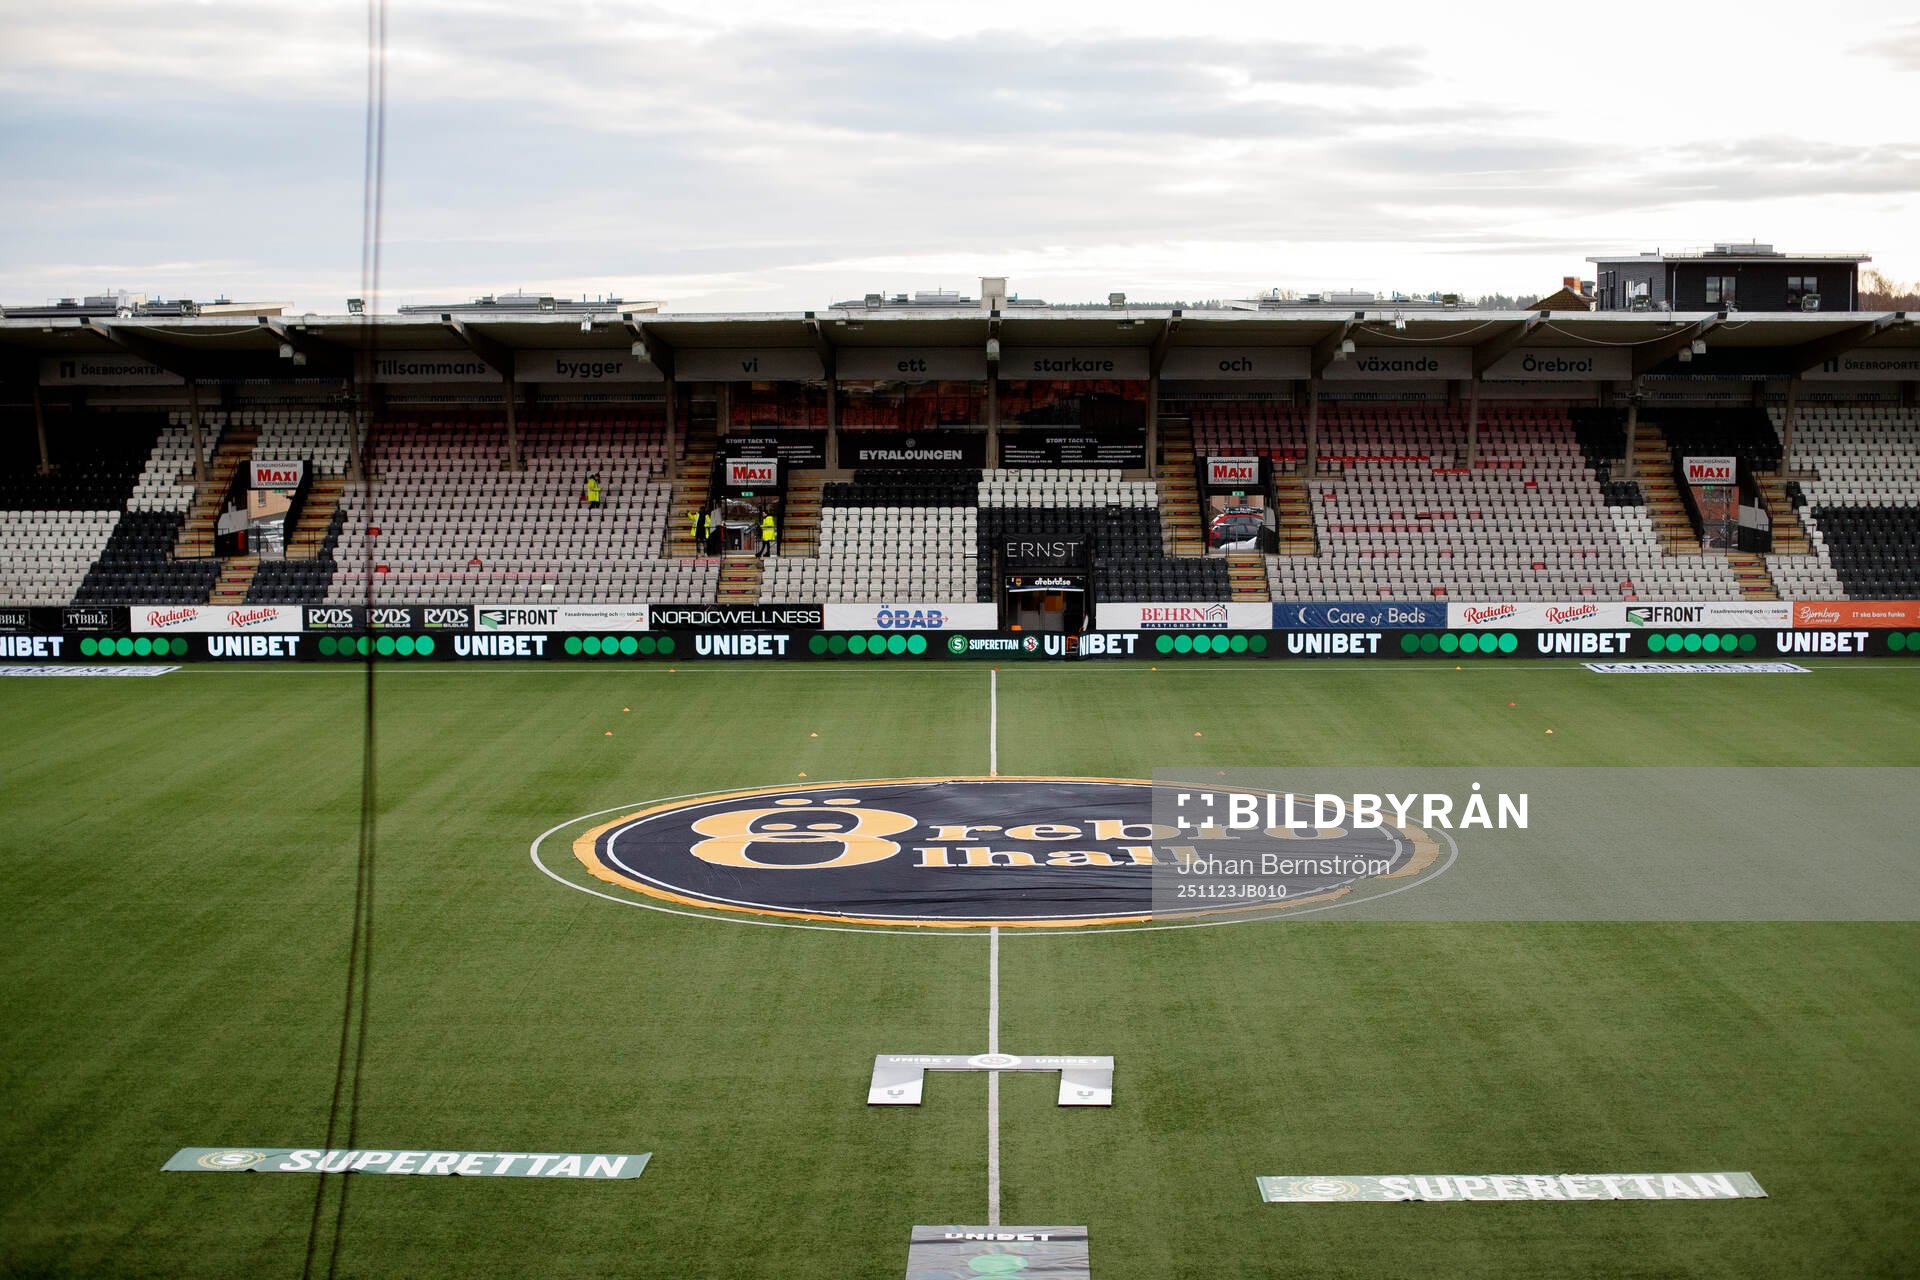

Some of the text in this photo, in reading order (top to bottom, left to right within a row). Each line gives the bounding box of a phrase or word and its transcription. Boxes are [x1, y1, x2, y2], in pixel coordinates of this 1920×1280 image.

[556, 360, 623, 378] bygger
[742, 358, 758, 373] vi
[897, 358, 927, 372] ett
[1033, 357, 1114, 372] starkare
[1219, 357, 1252, 372] och
[1357, 357, 1438, 372] växande
[1522, 354, 1593, 372] Örebro!
[859, 449, 963, 461] EYRALOUNGEN
[1007, 542, 1079, 558] ERNST
[66, 613, 108, 625] TYBBLE
[146, 607, 199, 627] Radiator
[226, 607, 279, 626] Radiator
[308, 608, 353, 624] RYDS
[366, 608, 411, 624] RYDS
[424, 608, 469, 624] RYDS
[508, 609, 557, 625] FRONT
[651, 610, 821, 624] NORDICWELLNESS
[876, 605, 944, 629] ÖBAB
[1141, 607, 1205, 621] BEHRN
[1326, 607, 1426, 626] Care of Beds
[1463, 604, 1517, 623] Radiator
[1545, 603, 1599, 623] Radiator
[1654, 606, 1704, 622] FRONT
[207, 635, 300, 657] UNIBET
[454, 635, 548, 656] UNIBET
[695, 634, 790, 656] UNIBET
[969, 639, 1019, 650] SUPERETTAN
[1287, 633, 1382, 654] UNIBET
[1537, 632, 1631, 653] UNIBET
[1776, 631, 1869, 652] UNIBET
[279, 1149, 629, 1178] SUPERETTAN
[1376, 1173, 1741, 1199] SUPERETTAN
